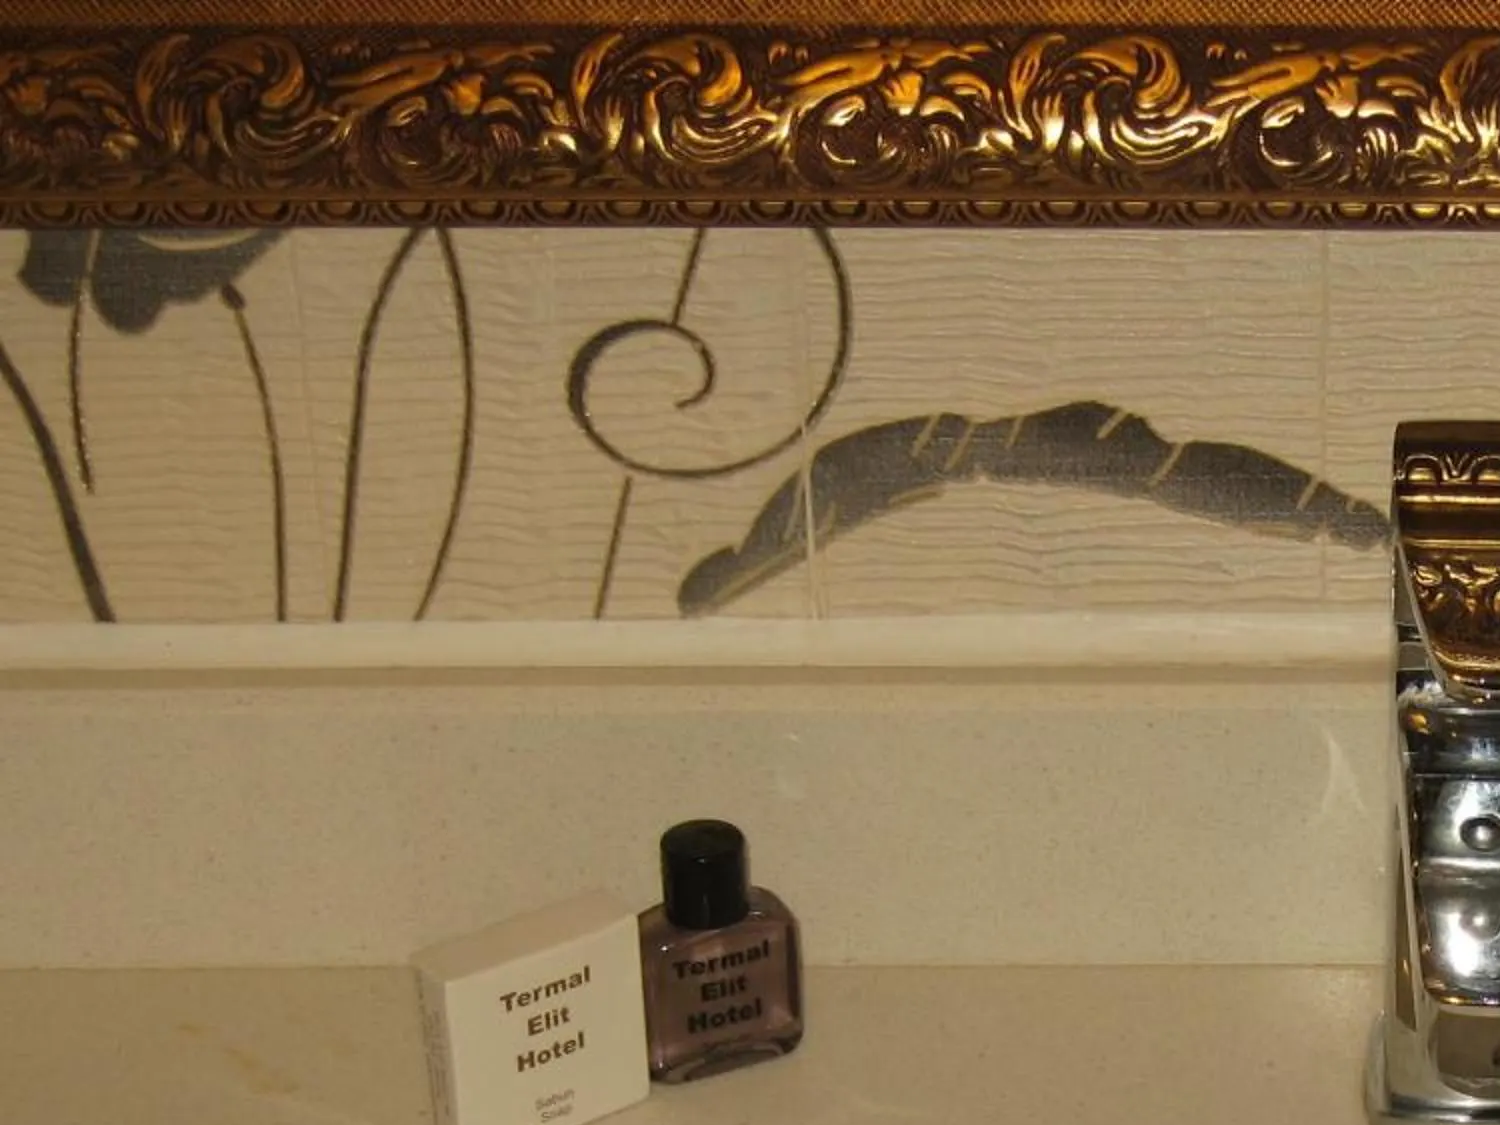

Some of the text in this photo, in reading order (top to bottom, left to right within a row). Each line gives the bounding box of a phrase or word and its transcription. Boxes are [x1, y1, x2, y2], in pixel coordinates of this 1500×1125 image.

[673, 939, 770, 980] Termal
[500, 966, 591, 1013] Termal
[702, 976, 748, 1002] Elit
[527, 1006, 570, 1037] Elit
[687, 998, 763, 1035] Hotel
[516, 1031, 585, 1073] Hotel
